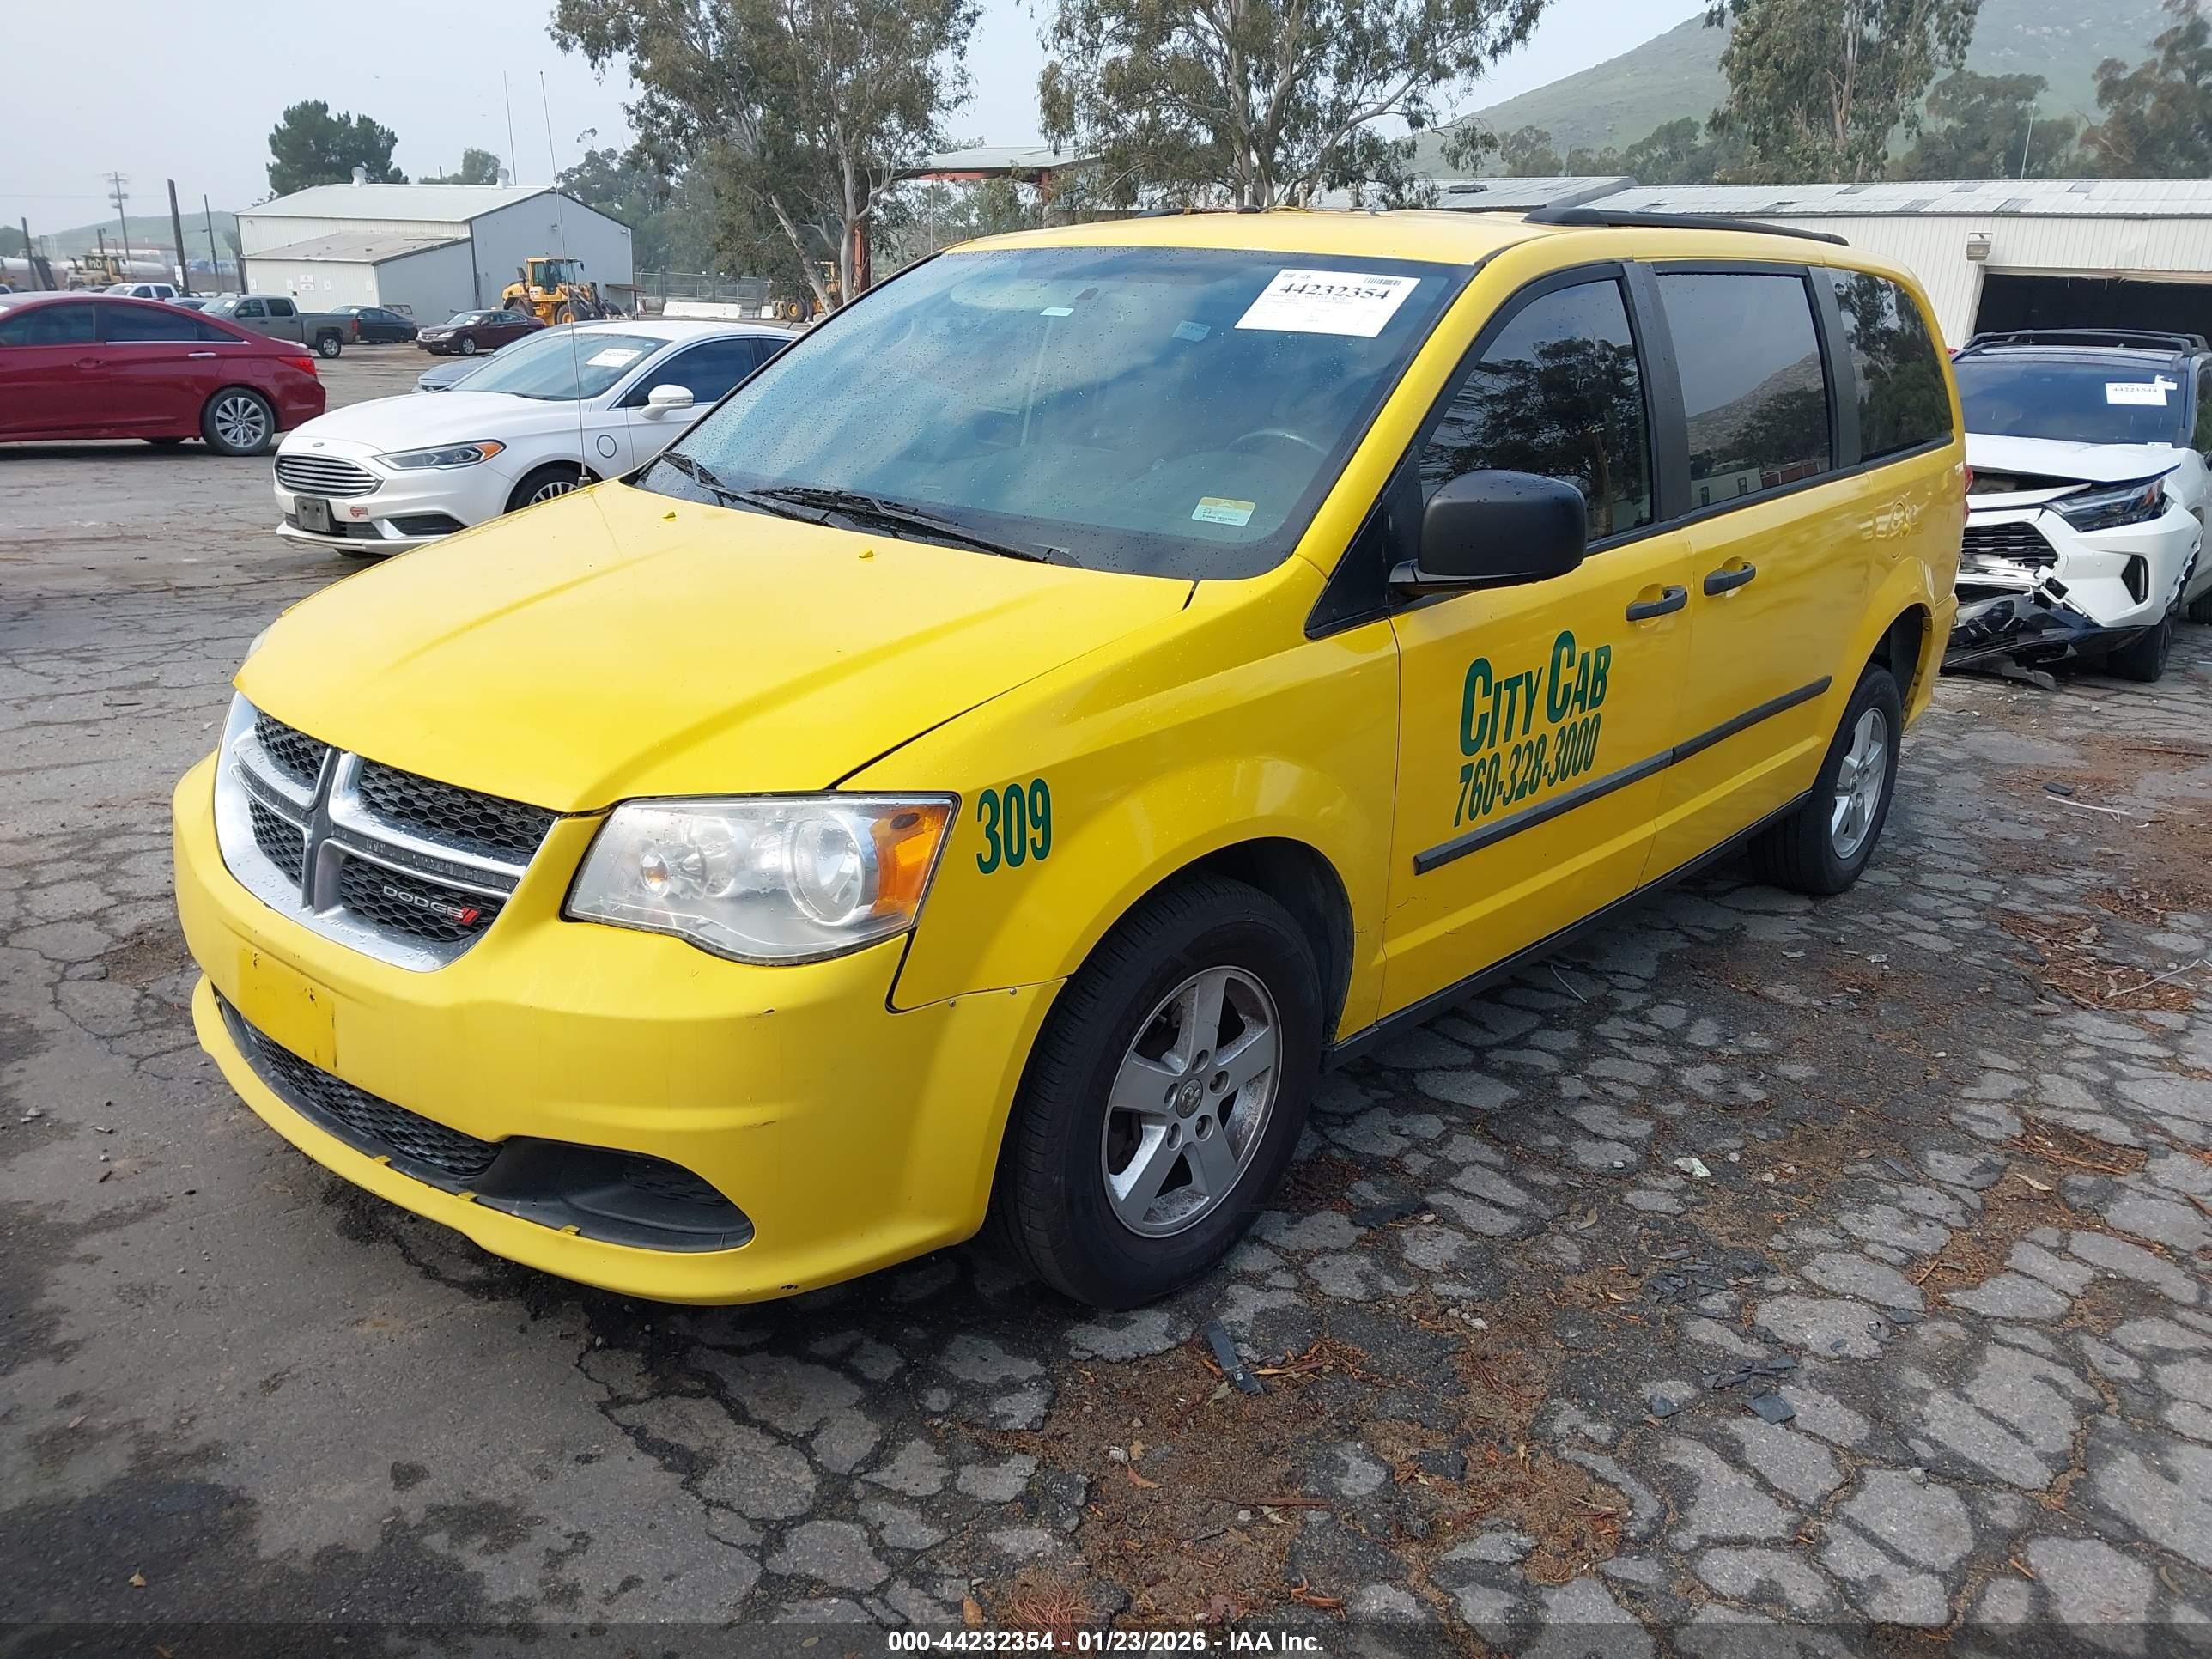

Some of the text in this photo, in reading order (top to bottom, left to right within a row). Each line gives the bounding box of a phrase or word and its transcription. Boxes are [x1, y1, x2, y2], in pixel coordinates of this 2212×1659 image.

[1279, 283, 1391, 300] 44232354
[1454, 712, 1601, 828] 760-328-3000
[976, 778, 1052, 874] 309
[383, 885, 464, 919] DODGE
